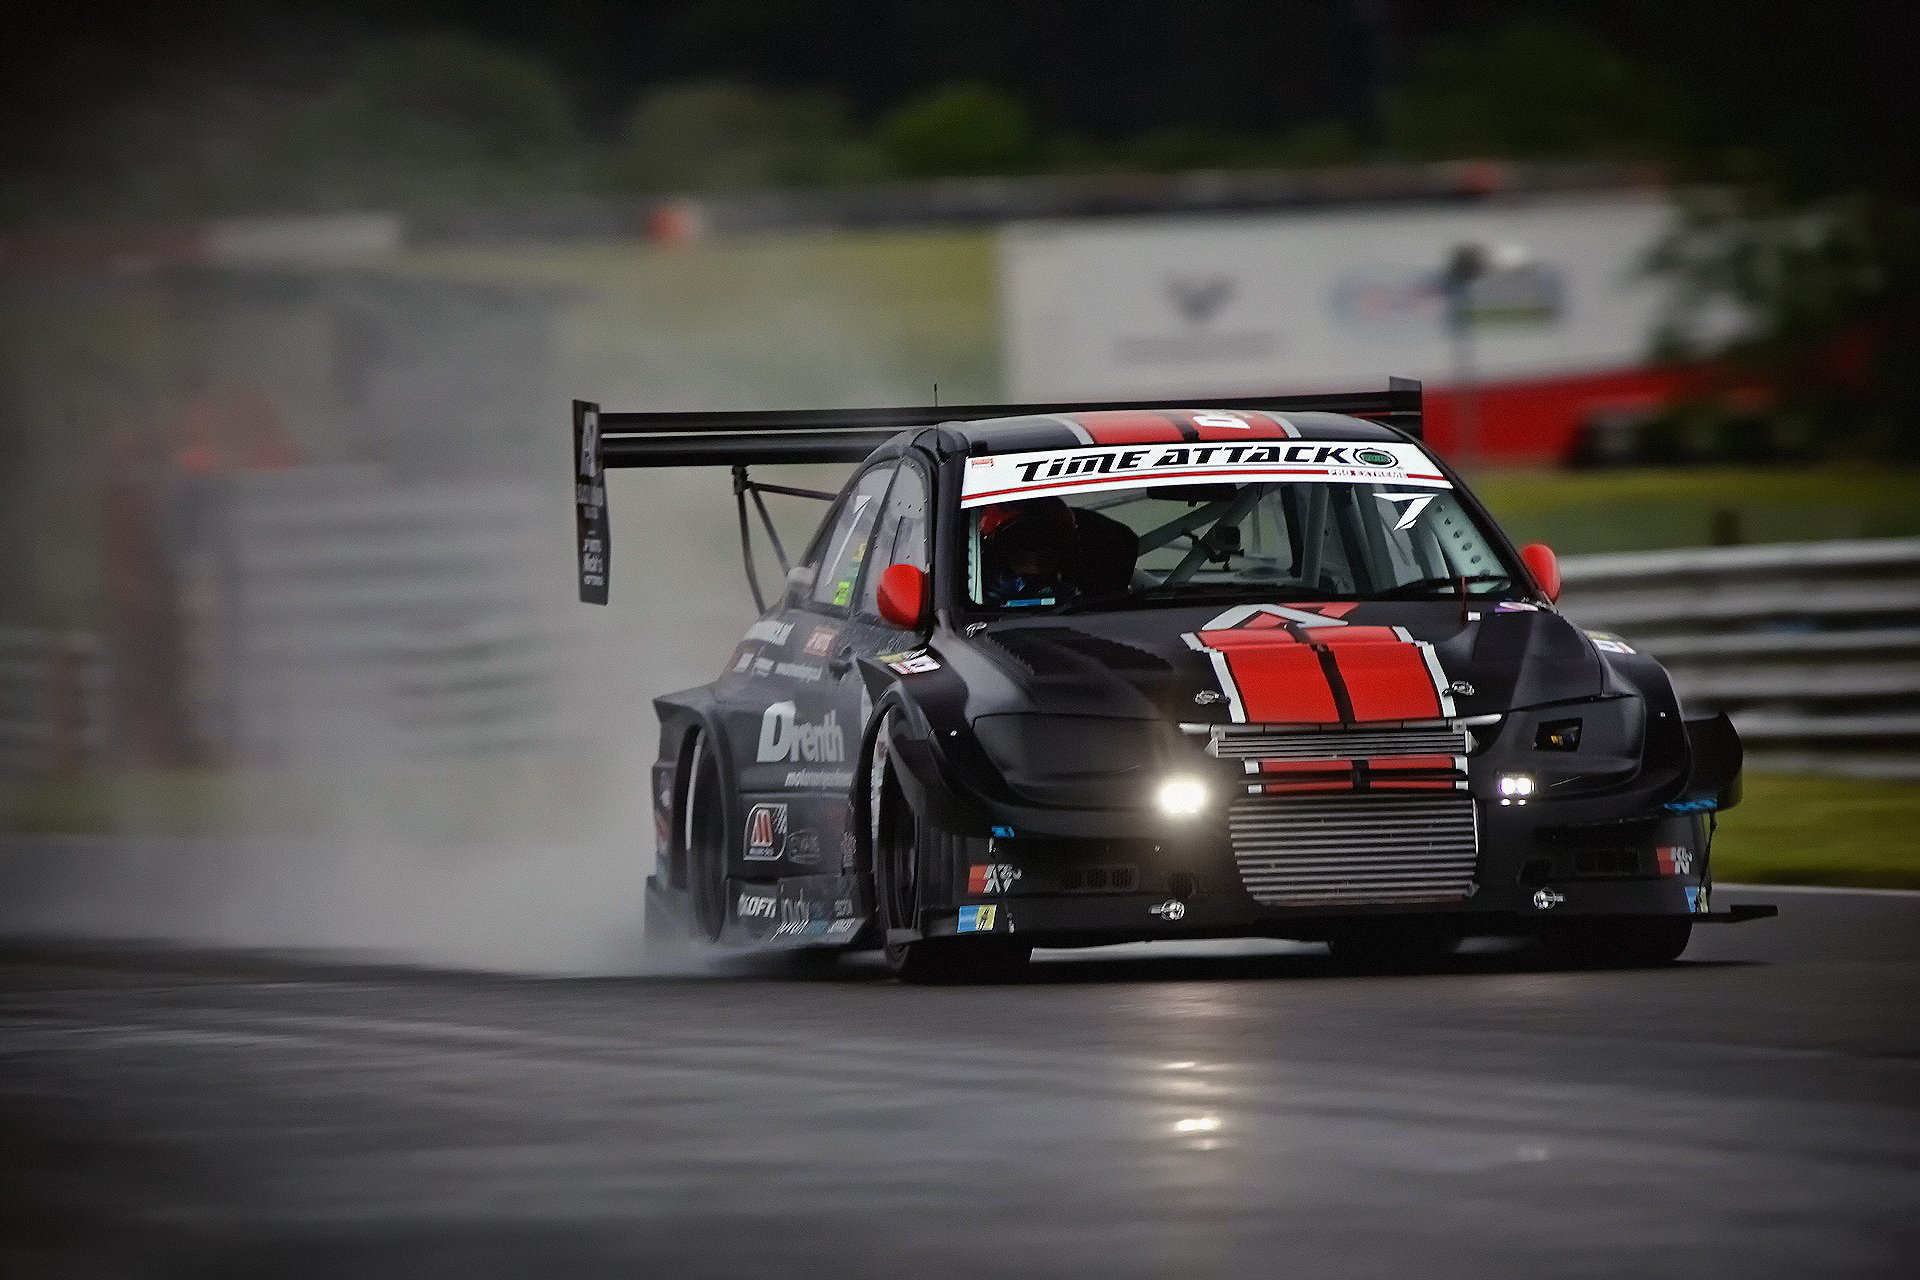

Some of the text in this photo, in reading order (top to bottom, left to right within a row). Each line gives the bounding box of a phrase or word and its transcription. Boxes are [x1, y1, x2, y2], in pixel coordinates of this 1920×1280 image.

[1151, 446, 1351, 468] ATTACK
[1373, 492, 1440, 531] 7
[756, 700, 845, 763] Drenth
